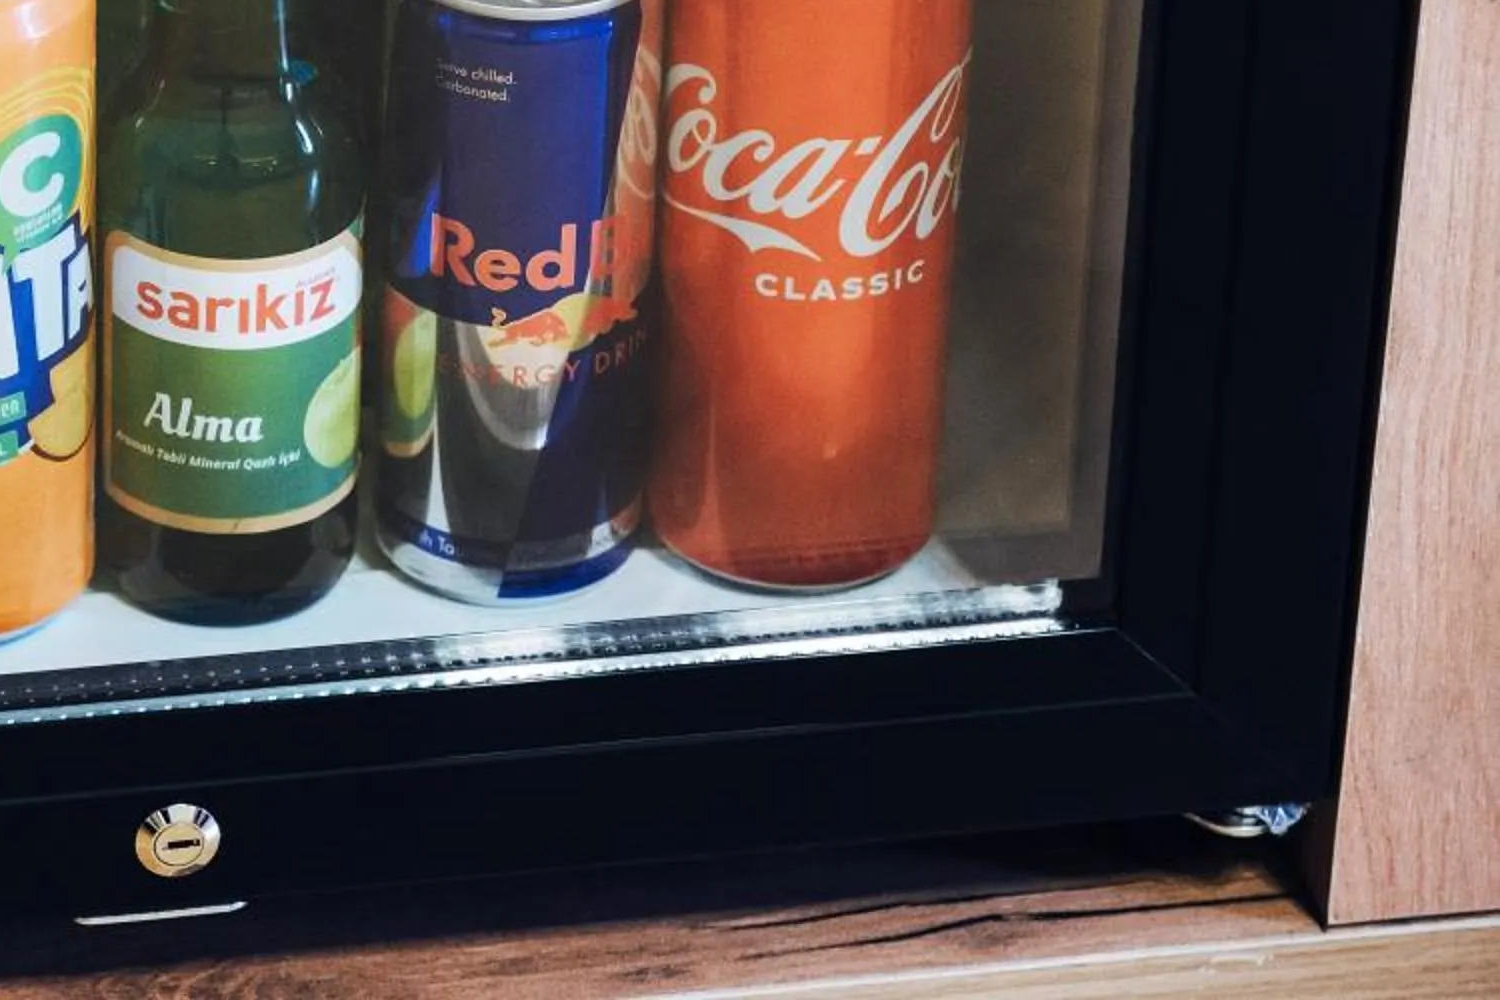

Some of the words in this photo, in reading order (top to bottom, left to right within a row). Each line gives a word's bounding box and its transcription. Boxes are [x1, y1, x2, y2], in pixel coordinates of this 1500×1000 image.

[0, 131, 65, 217] C
[429, 212, 577, 292] Red
[754, 259, 925, 302] CLASSIC
[143, 391, 264, 444] Alma
